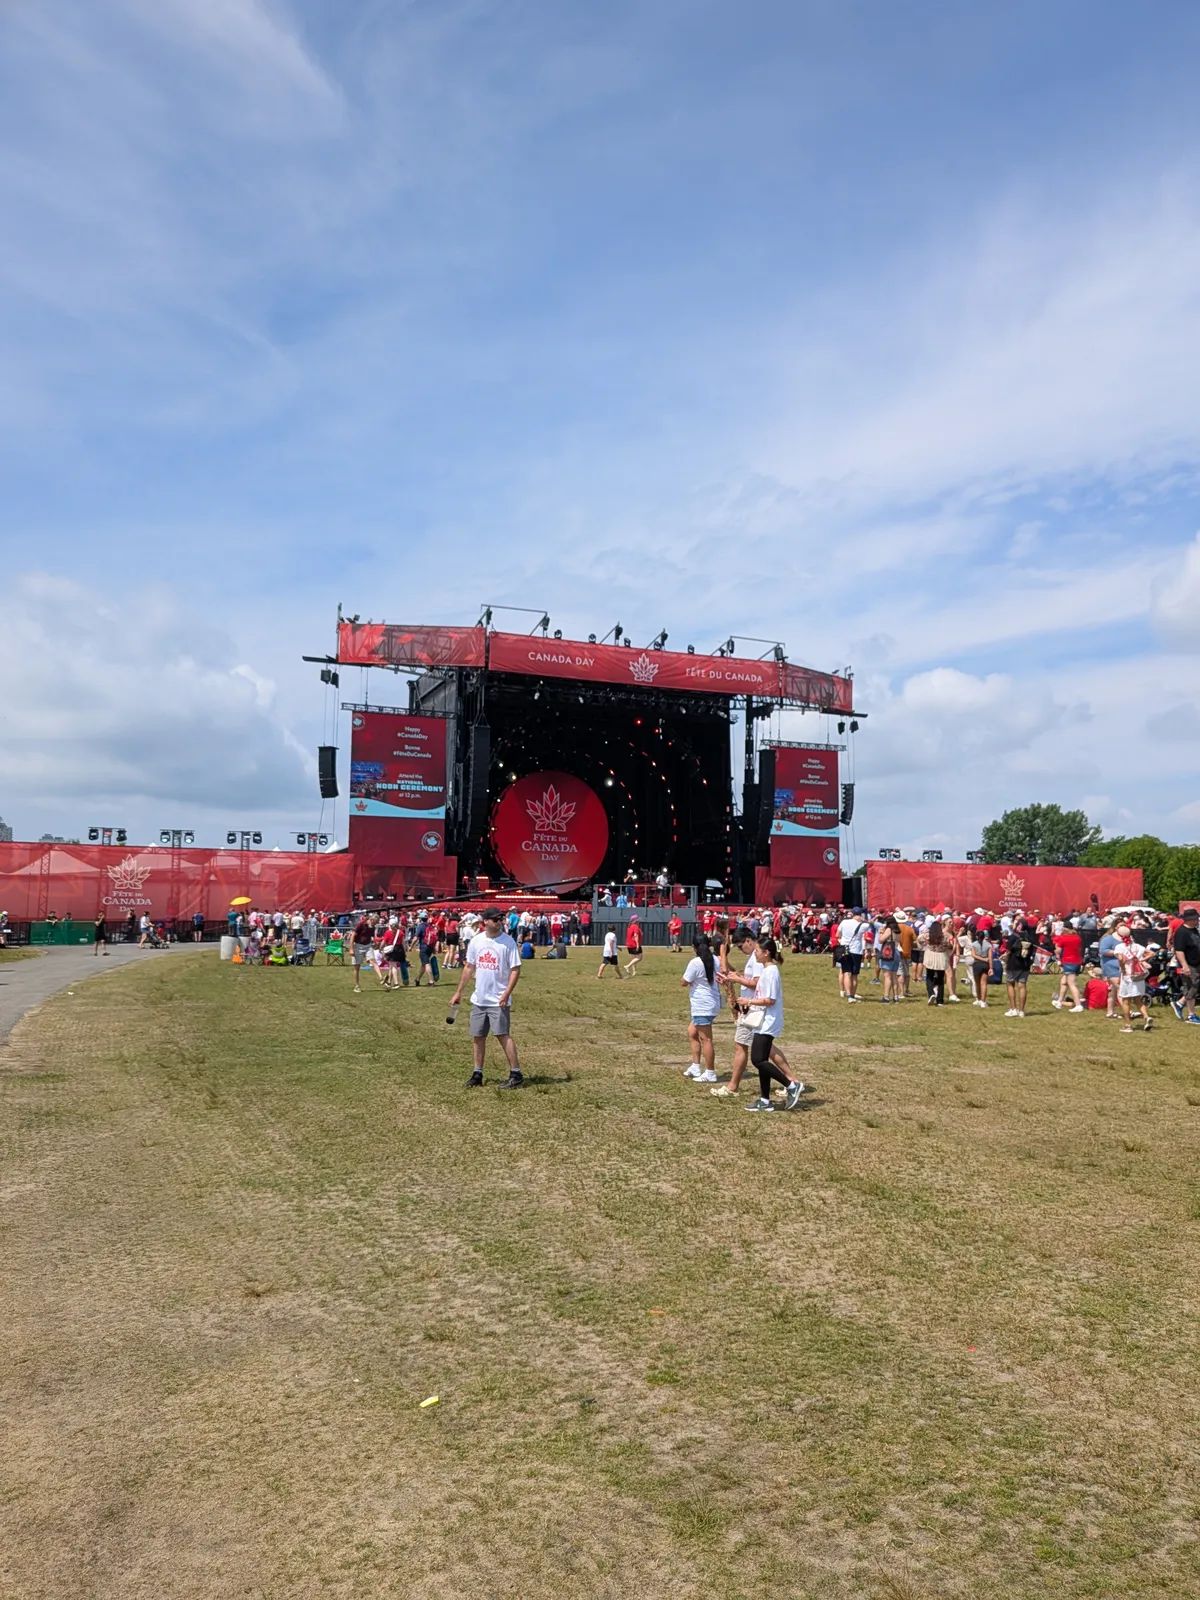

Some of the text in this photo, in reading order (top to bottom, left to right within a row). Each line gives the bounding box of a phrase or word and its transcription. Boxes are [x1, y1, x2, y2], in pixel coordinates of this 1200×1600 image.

[528, 651, 595, 667] CANADA DAY
[709, 670, 722, 679] DU
[725, 672, 763, 683] CANADA
[376, 782, 444, 792] NOON CEREMONY
[533, 833, 557, 841] FÊTE
[521, 840, 578, 853] CANADA
[541, 853, 559, 861] DAY
[102, 896, 152, 905] CANADA
